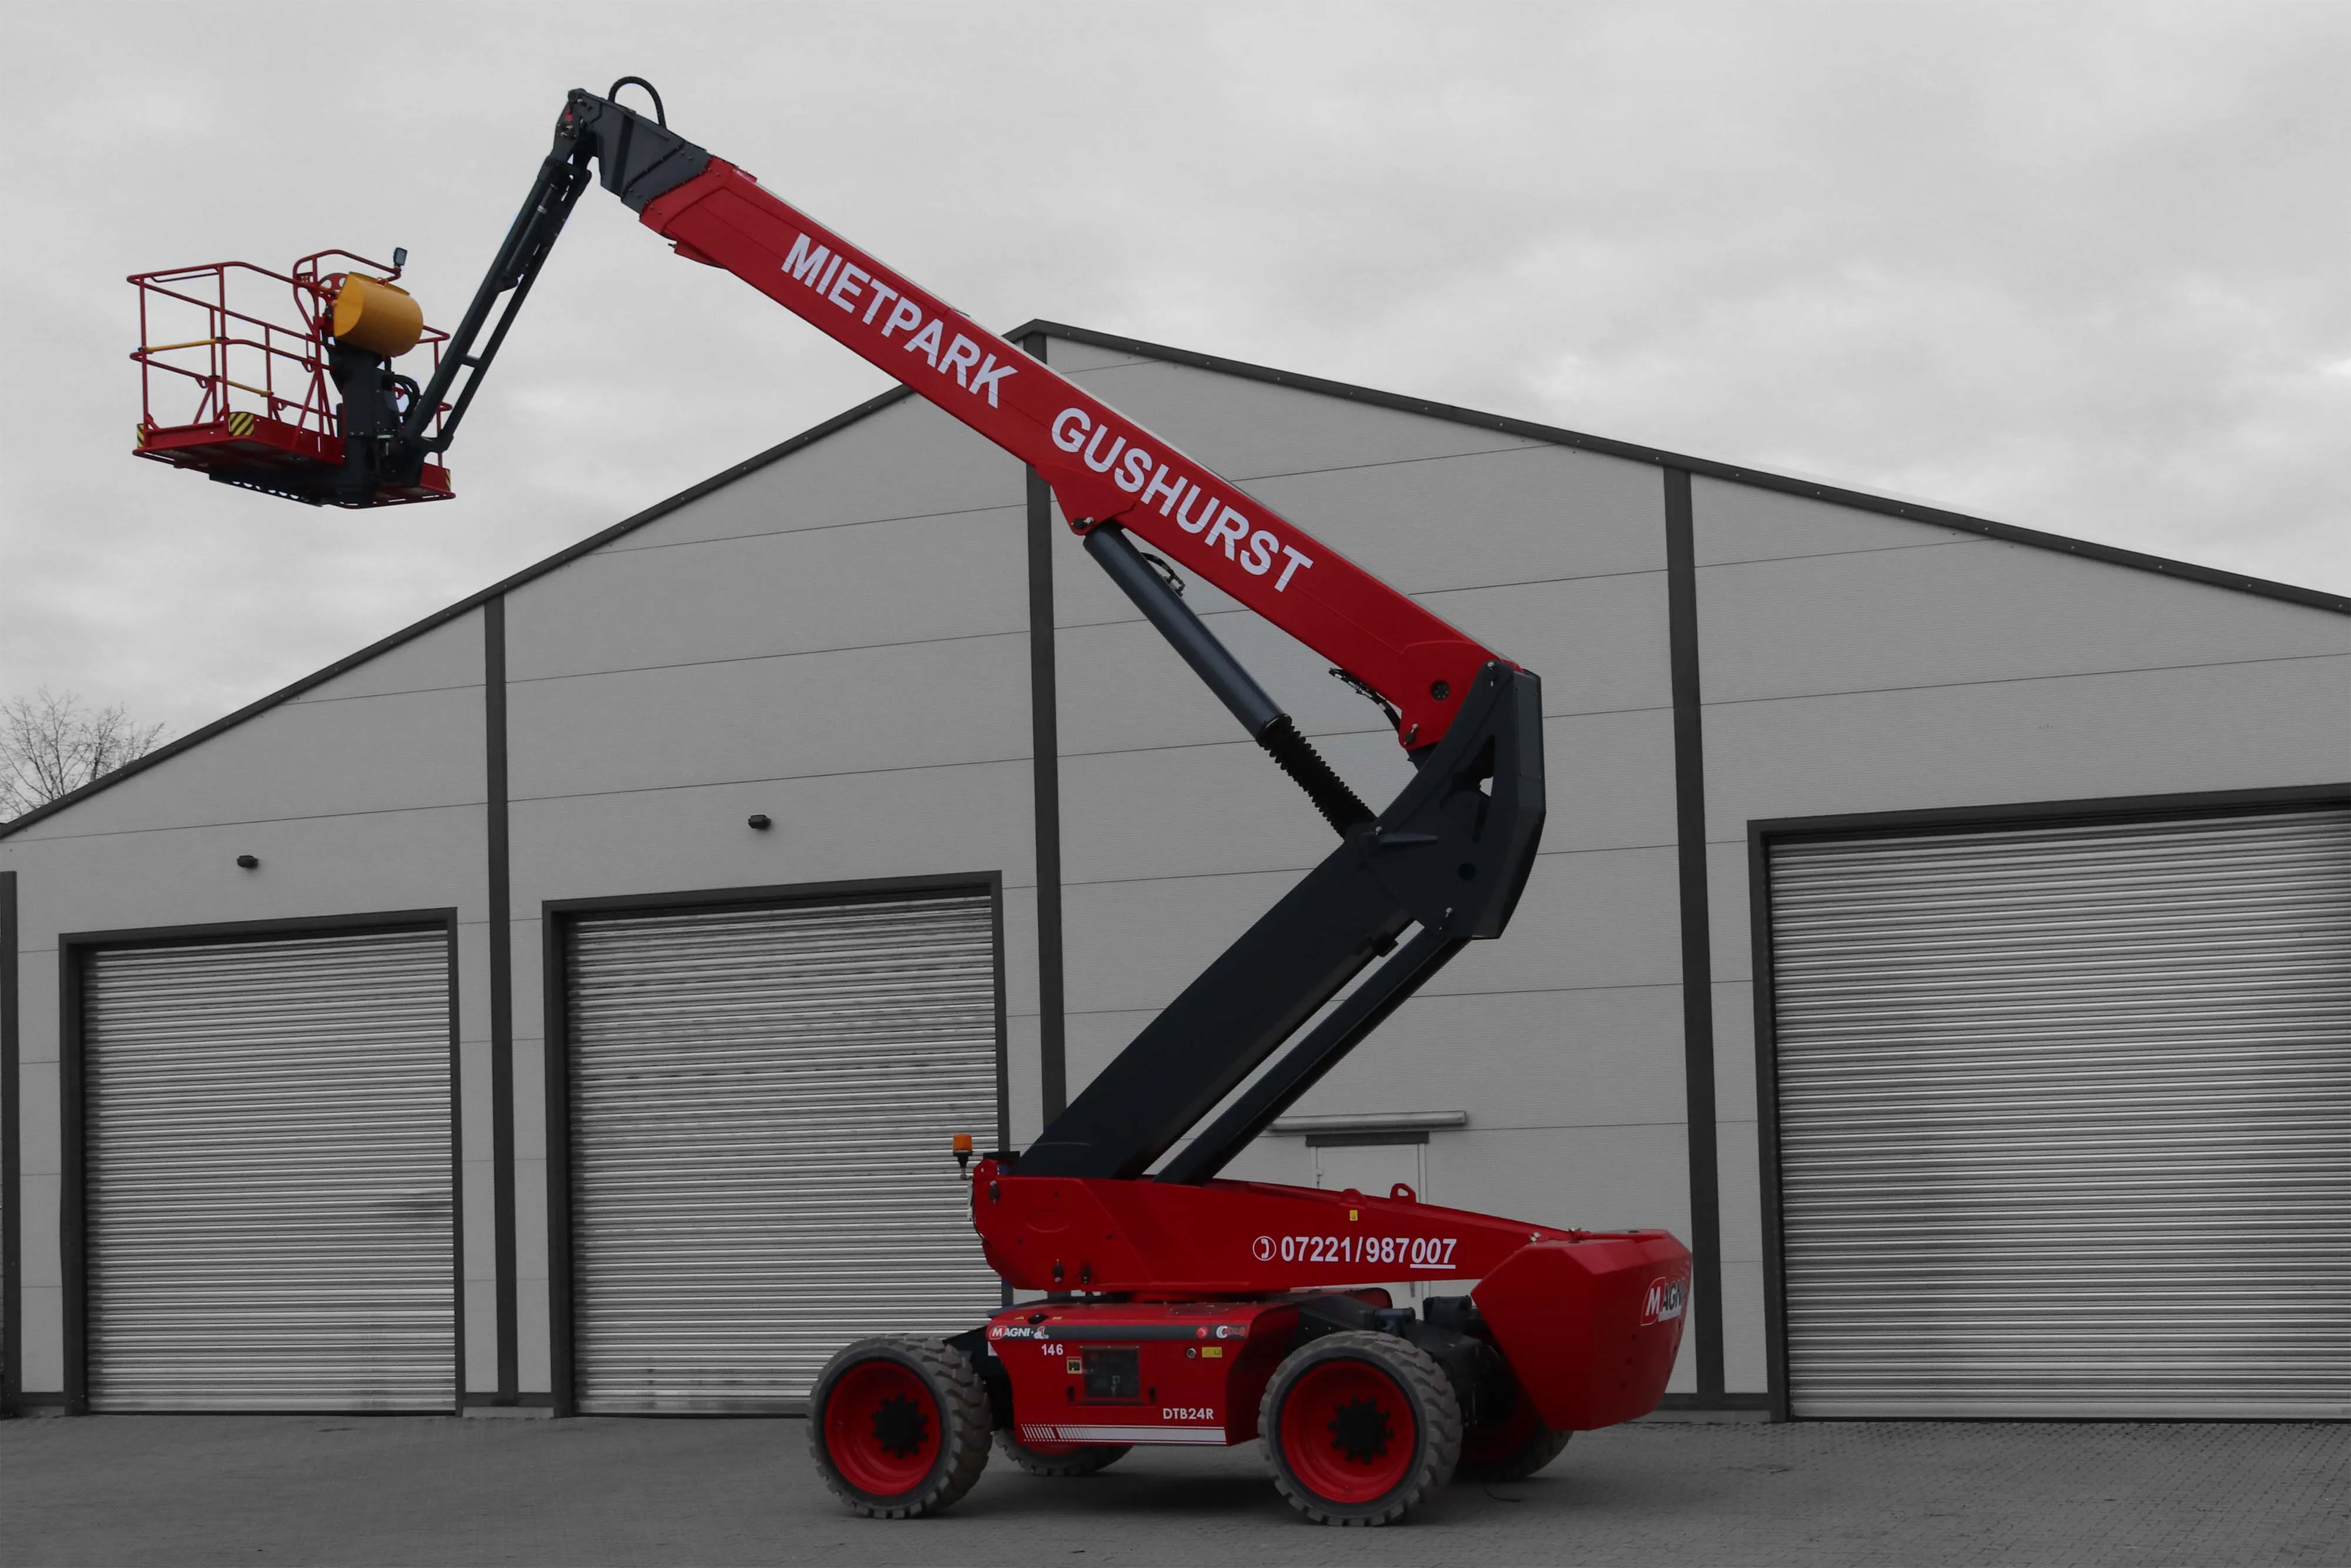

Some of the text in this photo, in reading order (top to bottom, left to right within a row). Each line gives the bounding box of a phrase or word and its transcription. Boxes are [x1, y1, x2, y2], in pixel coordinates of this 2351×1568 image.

[781, 233, 1314, 592] MIETPARK GUSHURST
[1281, 1236, 1457, 1266] 07221/987007
[992, 1328, 1031, 1337] MAGNI
[1041, 1343, 1063, 1355] 146
[1163, 1408, 1214, 1420] DTB24R
